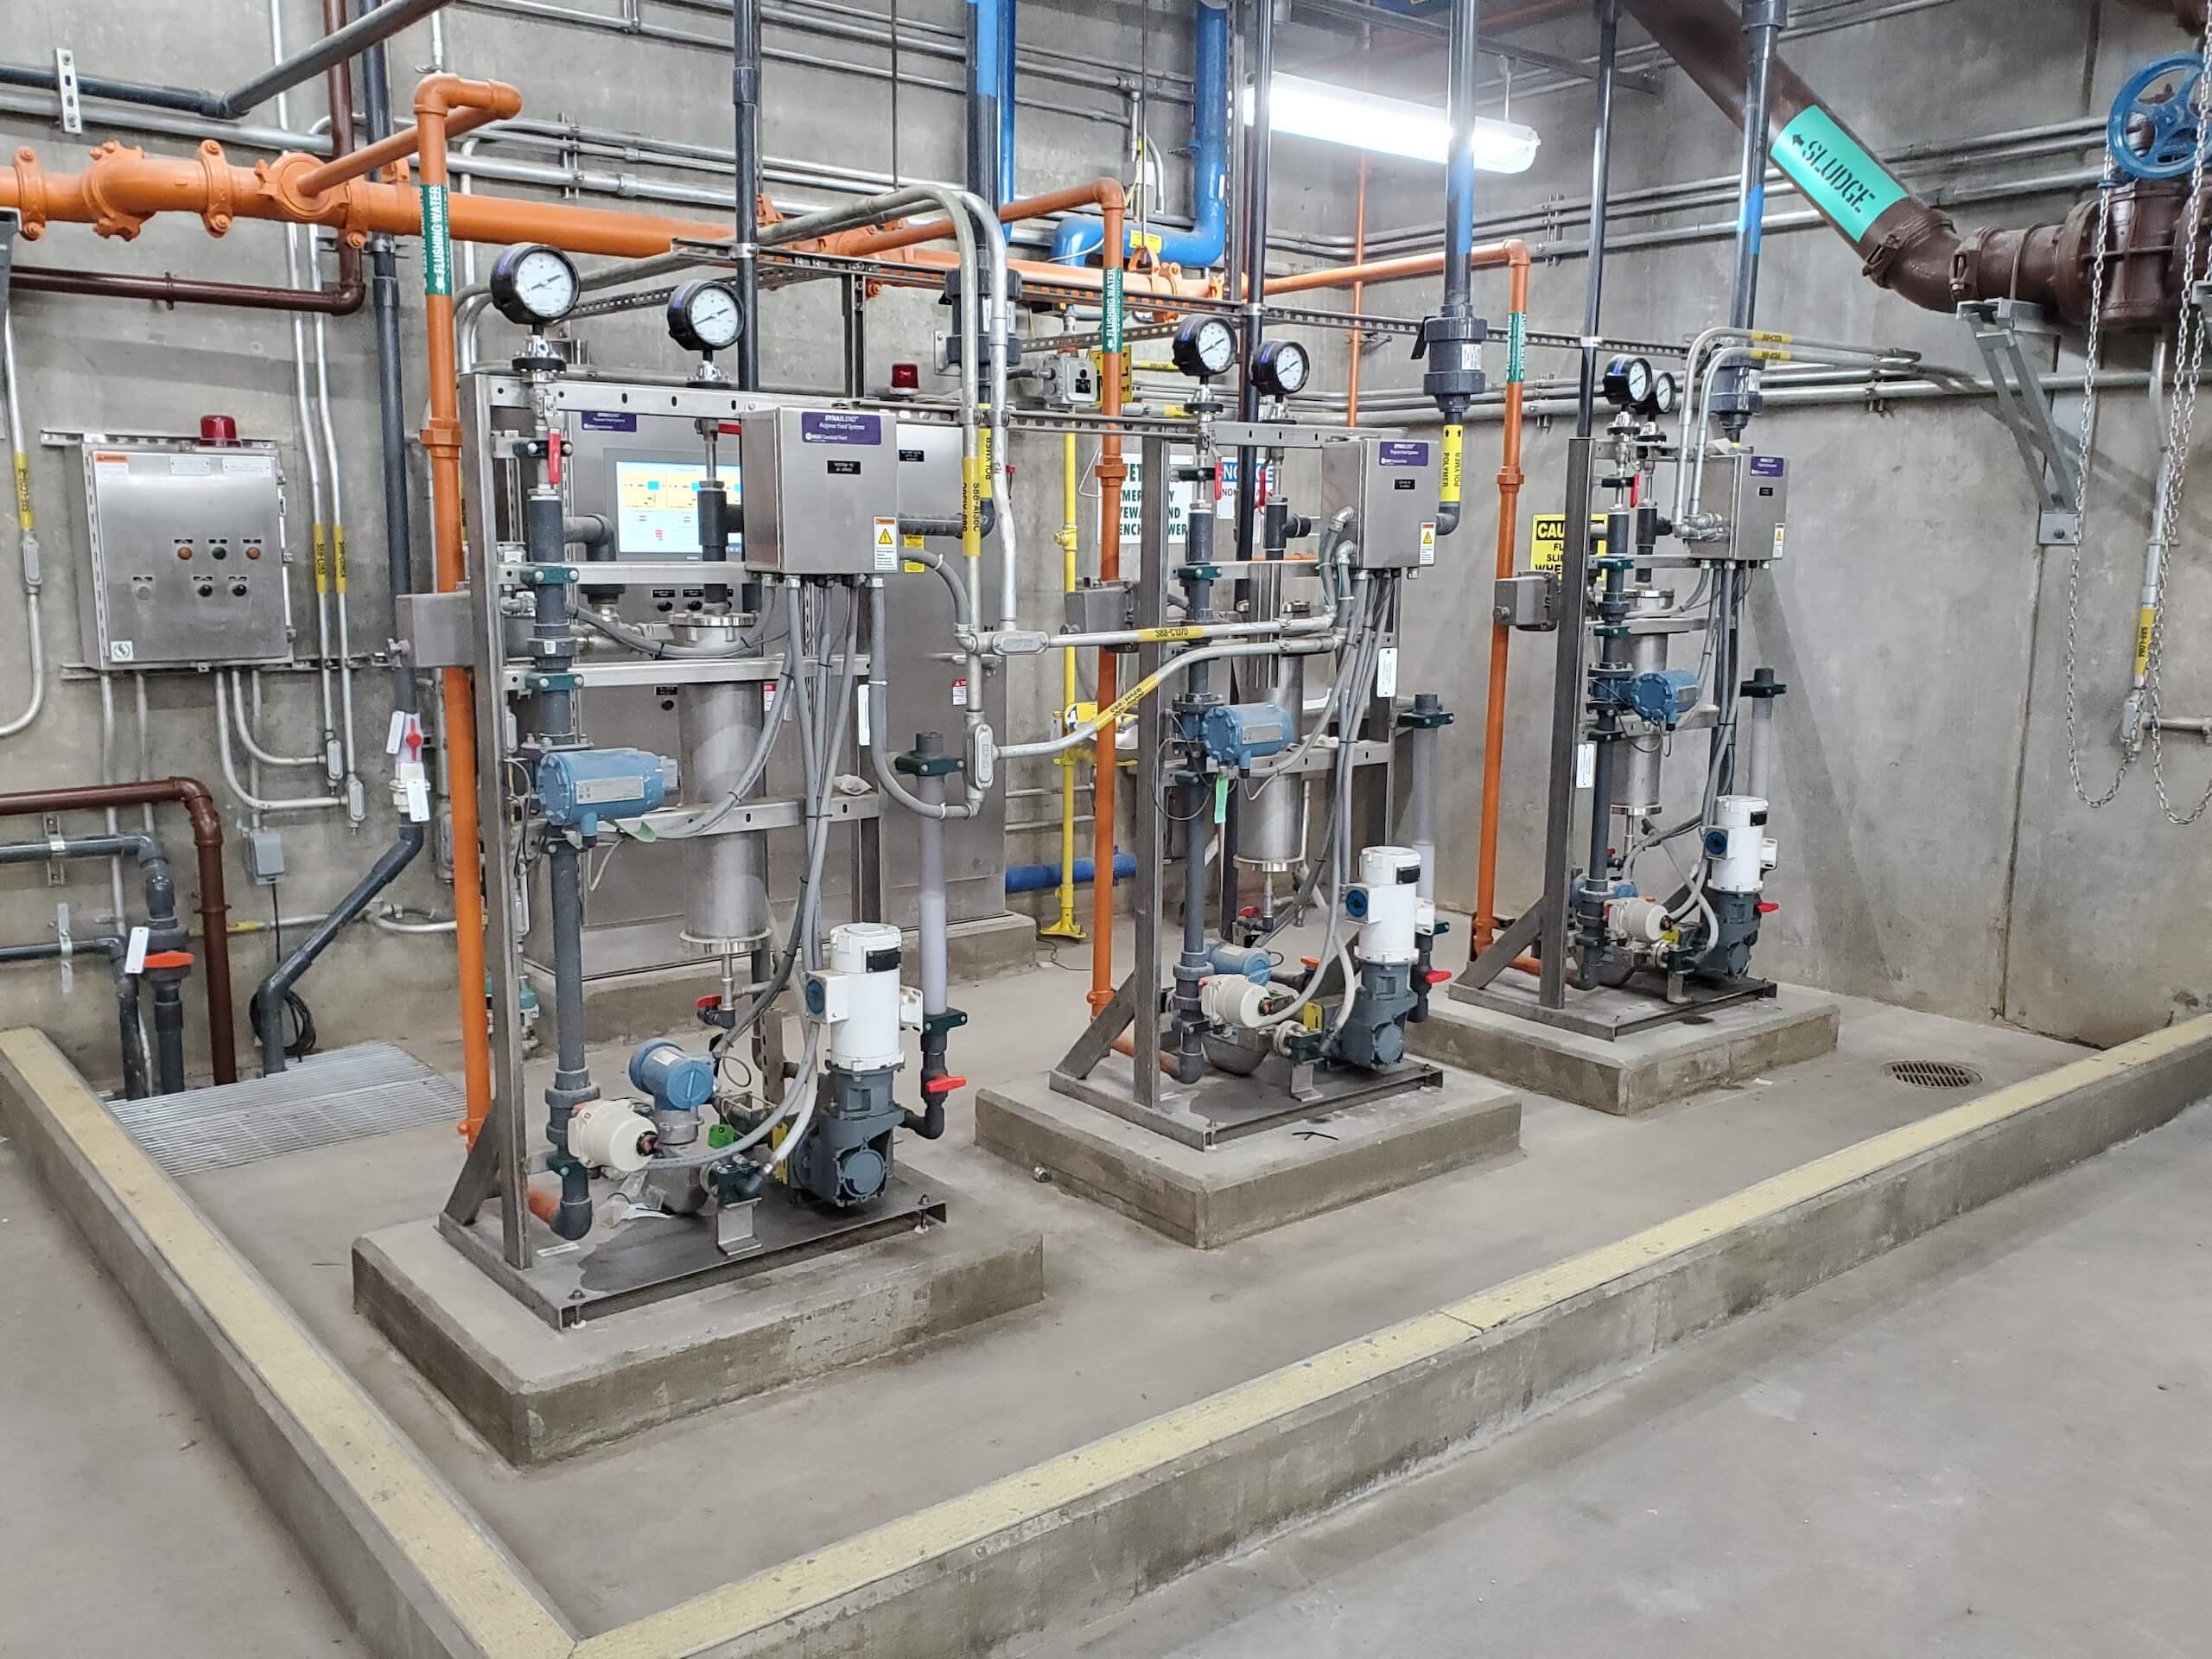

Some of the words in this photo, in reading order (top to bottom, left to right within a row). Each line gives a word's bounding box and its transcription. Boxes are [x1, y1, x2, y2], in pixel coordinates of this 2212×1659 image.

[1802, 140, 1876, 213] SLUDGE
[429, 184, 442, 222] WATER
[431, 223, 444, 273] FLUSHING
[1106, 268, 1116, 296] WATER
[1106, 298, 1116, 336] FLUSHING
